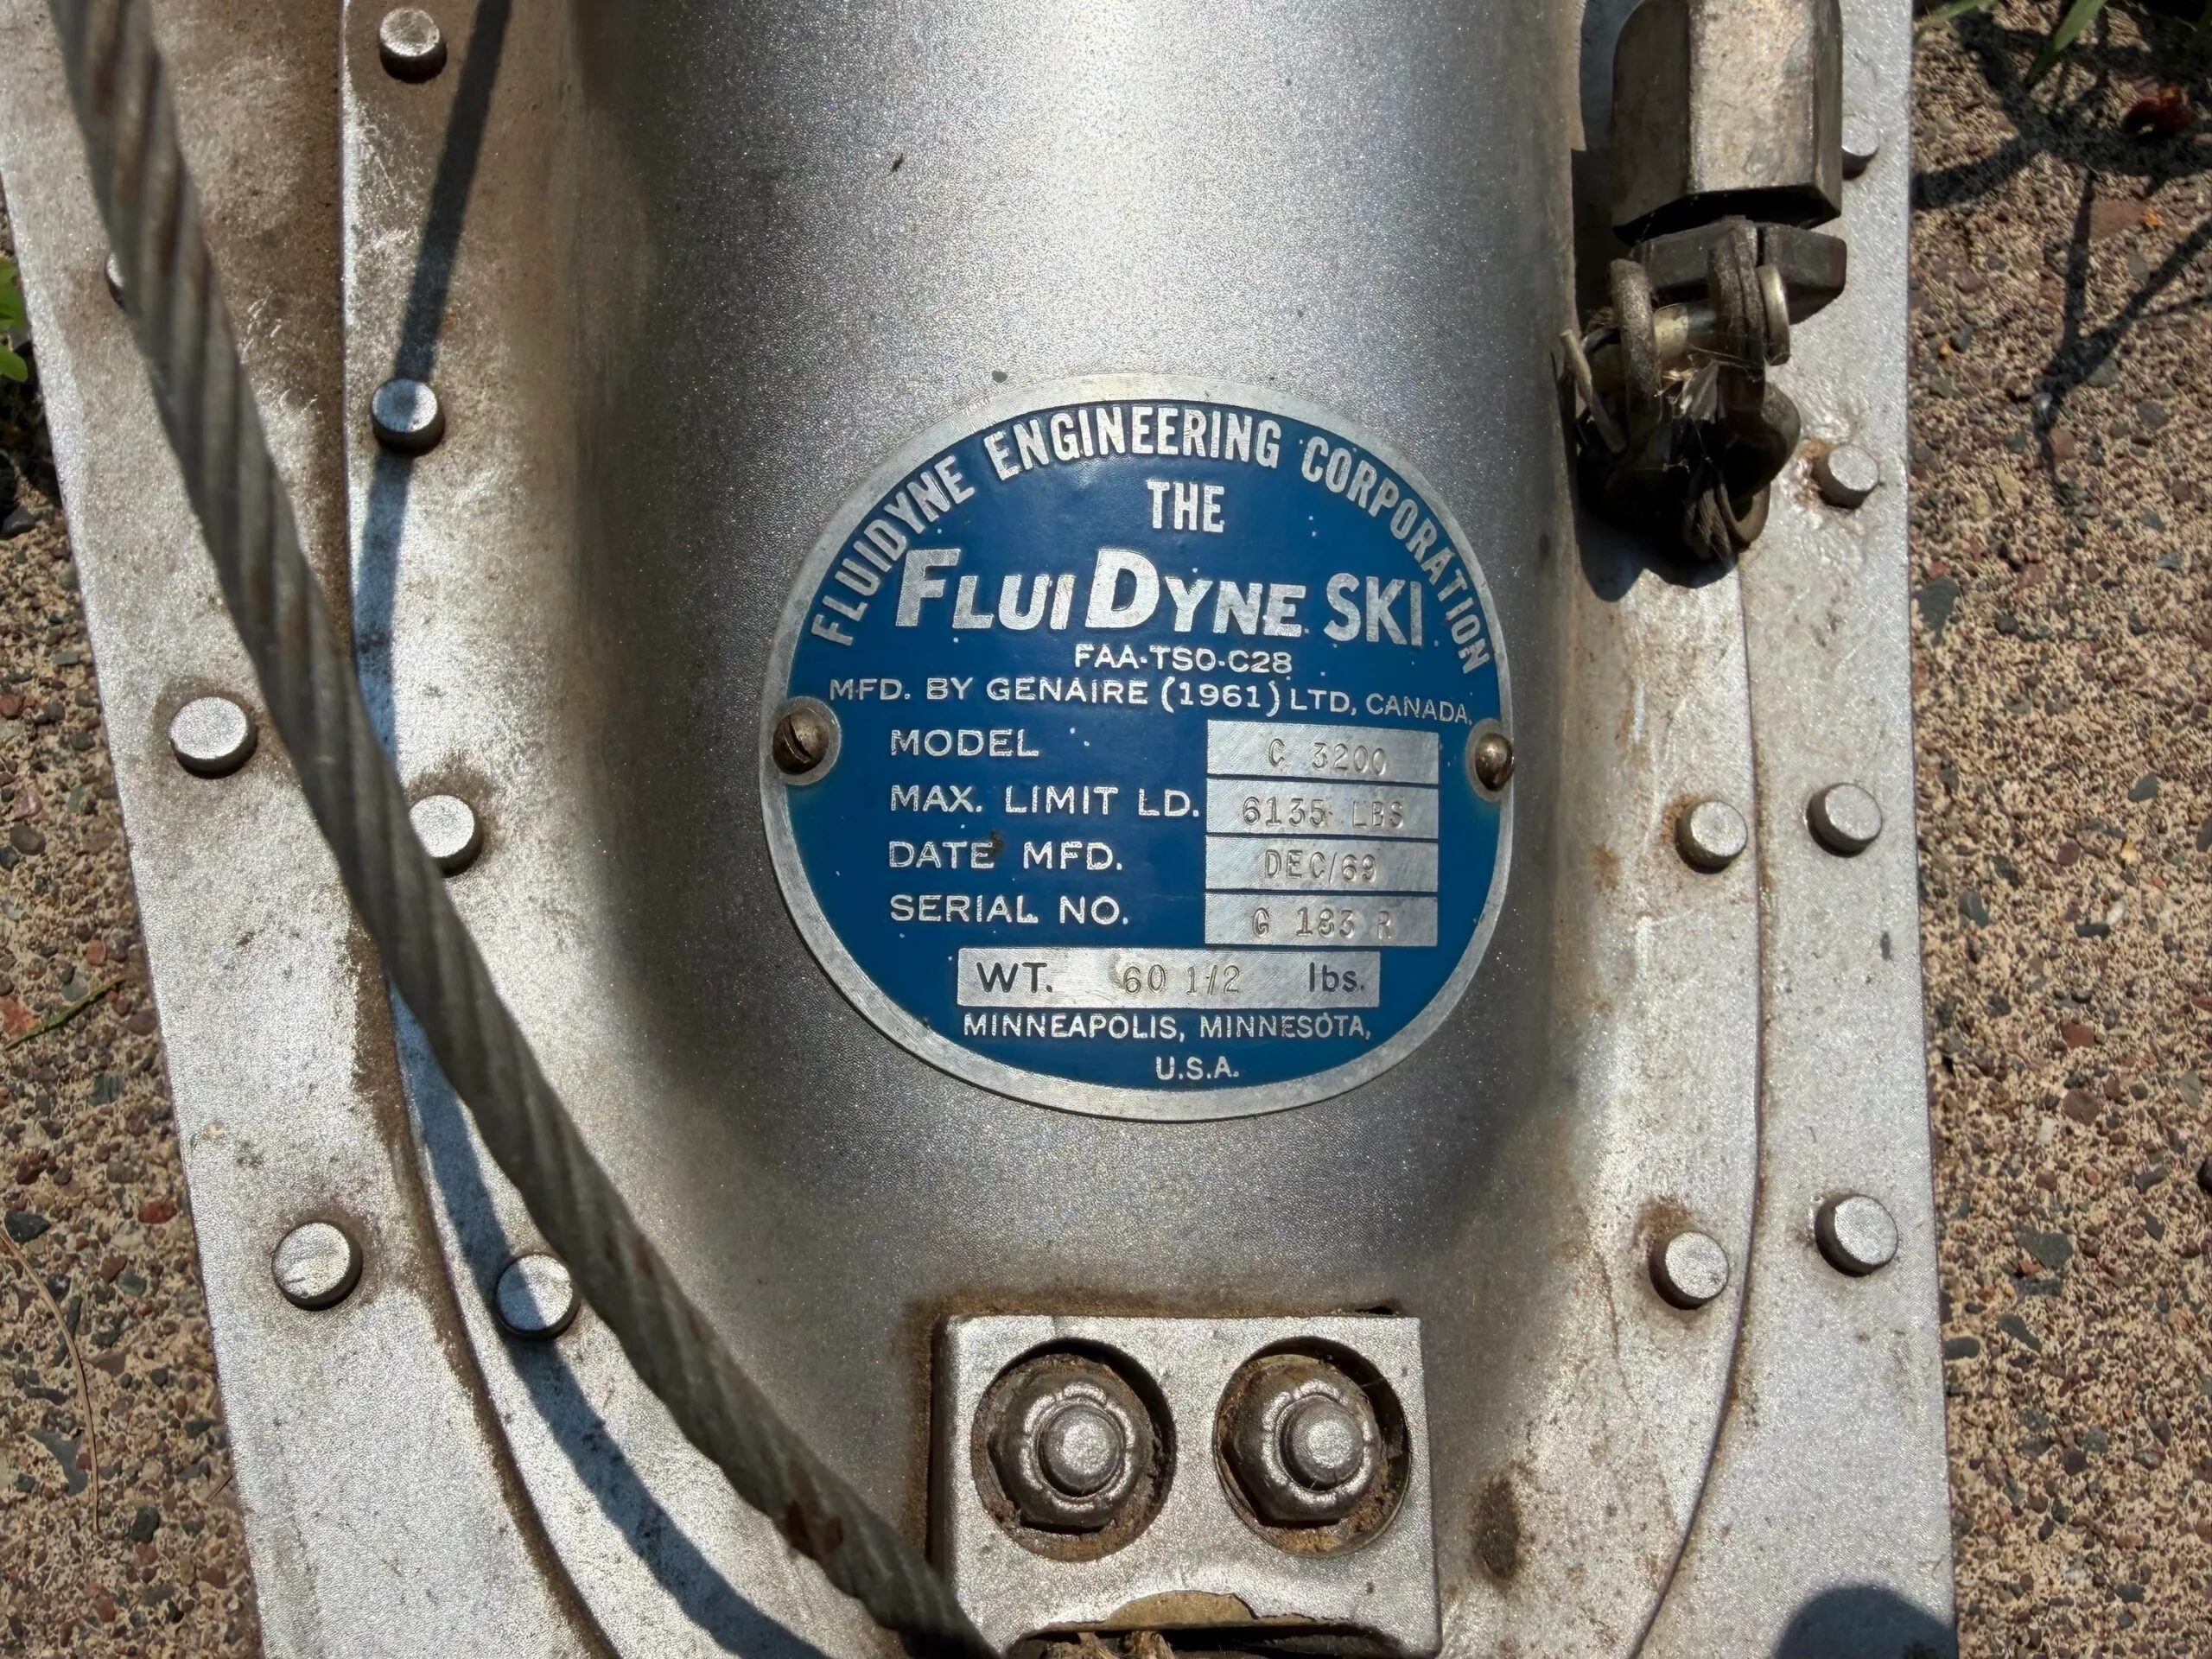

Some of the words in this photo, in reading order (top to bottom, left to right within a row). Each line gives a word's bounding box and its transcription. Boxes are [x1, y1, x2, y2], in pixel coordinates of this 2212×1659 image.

[1147, 480, 1225, 532] THE
[810, 456, 975, 646] FLUIDYNE
[983, 408, 1279, 481] ENGINEERING
[1302, 435, 1491, 675] CORPORATION
[1324, 573, 1423, 646] SKI
[830, 678, 911, 701] MFD.
[926, 677, 973, 700] BY
[986, 677, 1148, 705] GENAIRE
[1161, 676, 1280, 717] (1961)
[891, 729, 1039, 757] MODEL
[1268, 738, 1285, 767] C
[1312, 741, 1387, 776] 3200
[890, 785, 982, 813] MAX.
[1005, 785, 1118, 815] LIMIT
[1138, 788, 1200, 818] LD.
[1243, 796, 1325, 827] 6135
[1352, 800, 1404, 829] LBS
[888, 841, 995, 869] DATE
[1024, 841, 1122, 871] MFD.
[1264, 849, 1376, 883] DEC/69
[890, 894, 1038, 923] SERIAL
[1059, 895, 1128, 925] NO.
[976, 962, 1053, 993] WT.
[1122, 964, 1166, 994] 60
[1185, 963, 1241, 994] 1/2
[1309, 961, 1365, 992] lbs.
[963, 1012, 1185, 1042] MINNEAPOLIS,
[1155, 1057, 1240, 1080] U.S.A.
